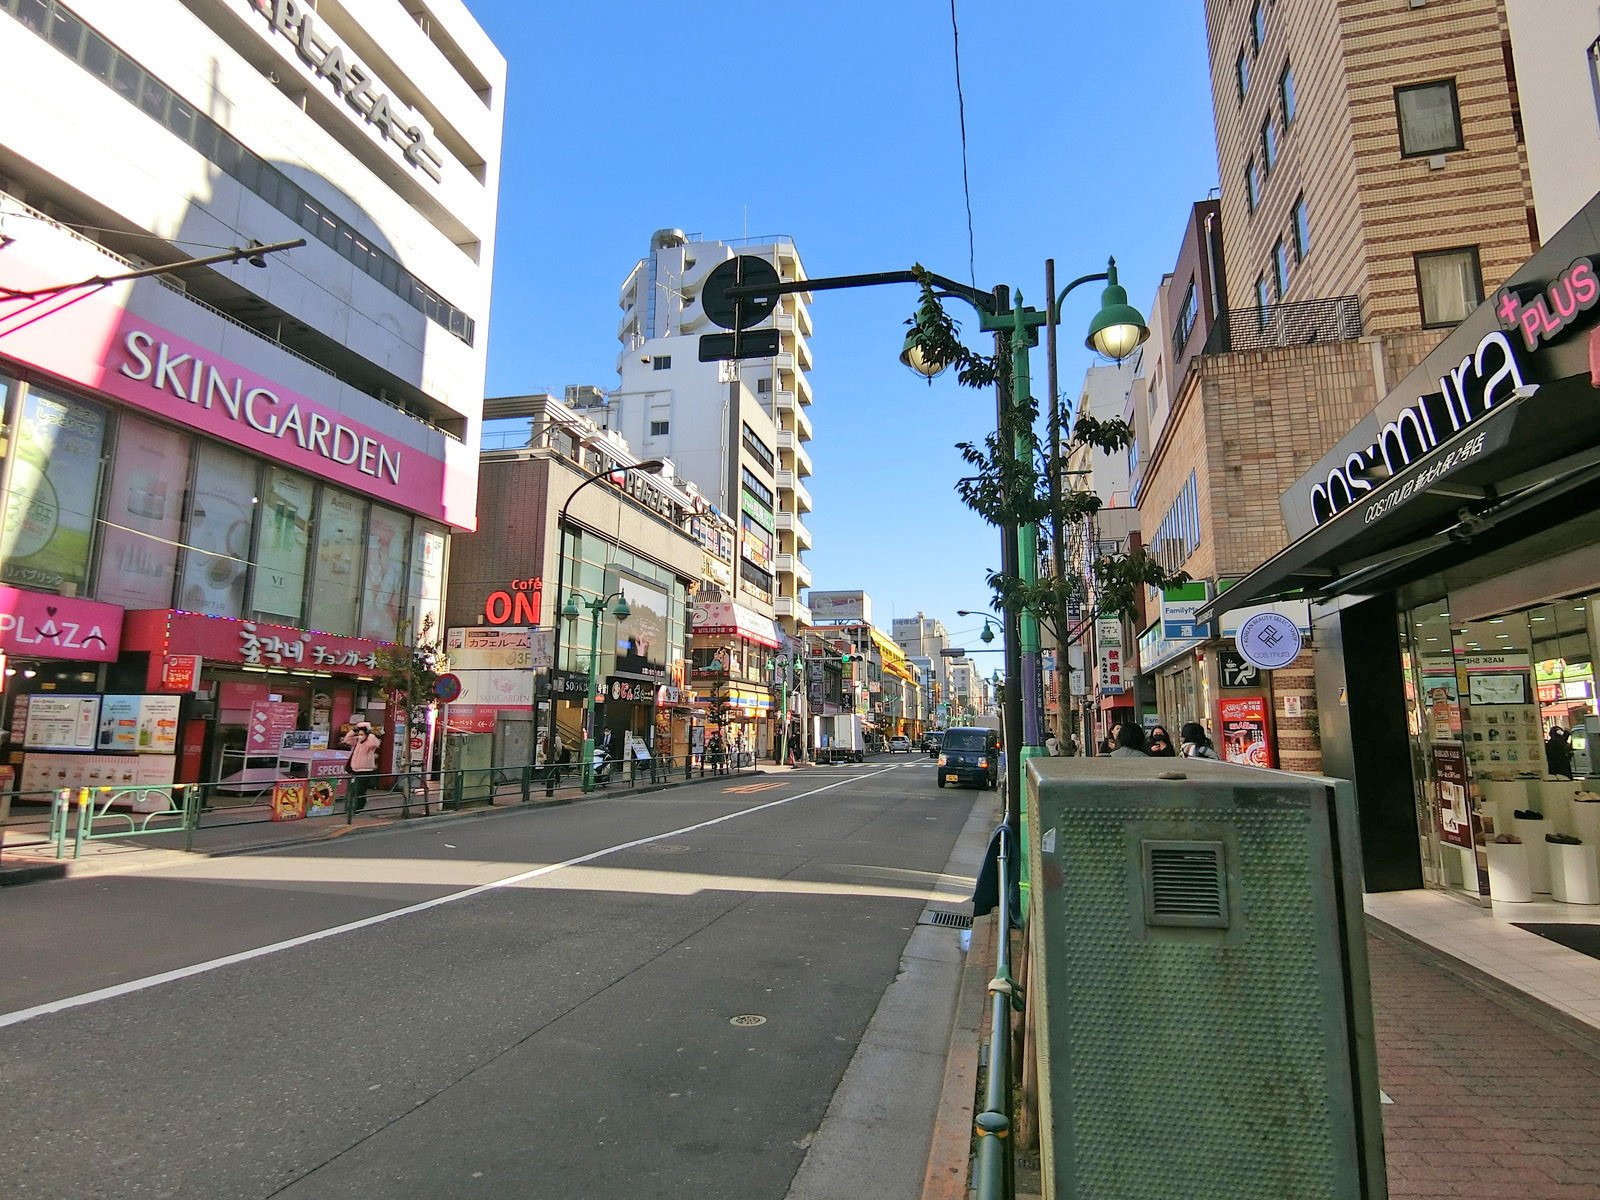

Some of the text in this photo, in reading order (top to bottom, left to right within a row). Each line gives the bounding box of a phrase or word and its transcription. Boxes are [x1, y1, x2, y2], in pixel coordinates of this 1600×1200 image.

[271, 0, 395, 133] PLAZA
[118, 329, 402, 486] SKINGARDEN
[511, 577, 543, 590] Café
[485, 591, 541, 625] ON
[0, 613, 107, 651] PLAZA
[469, 638, 527, 648] カフェルーム
[517, 652, 532, 664] 3F
